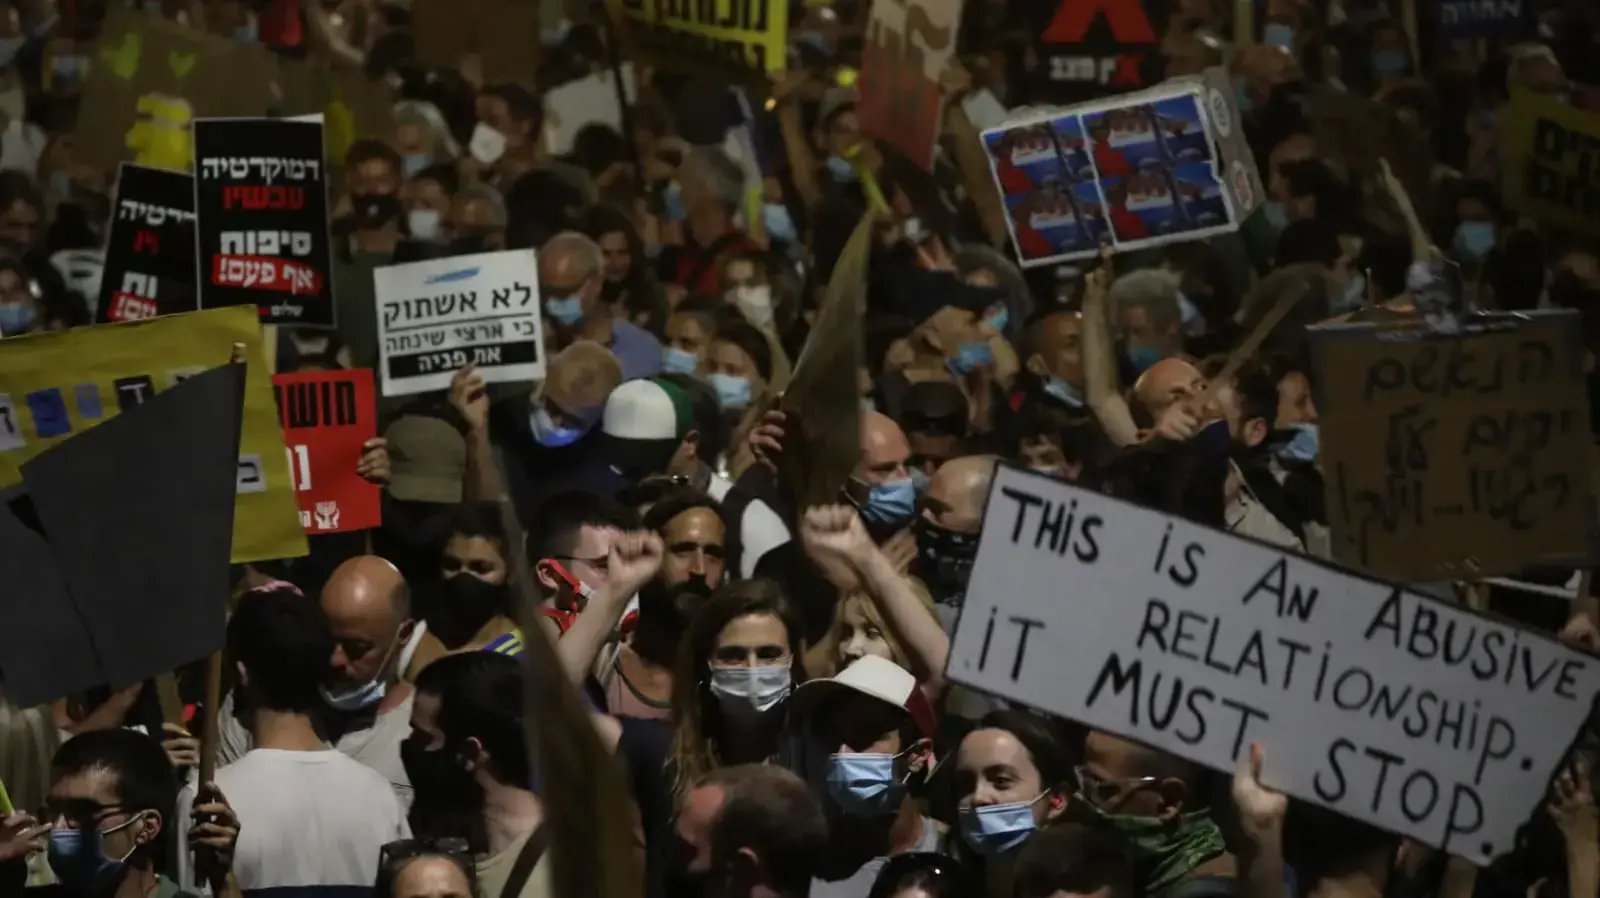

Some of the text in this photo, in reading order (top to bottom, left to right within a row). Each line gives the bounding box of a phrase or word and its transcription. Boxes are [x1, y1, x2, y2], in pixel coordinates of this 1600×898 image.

[201, 156, 320, 186] דמוקרטיה
[221, 185, 305, 211] עכשיו
[219, 230, 312, 256] סיפוח
[219, 257, 314, 295] אף פעם!
[384, 281, 531, 328] לא אשתוק
[386, 321, 534, 352] כי ארצי שינתה
[417, 347, 502, 372] את פניה
[1243, 558, 1318, 622] AN
[1086, 653, 1269, 762] MUST
[1314, 738, 1492, 854] STOP.
